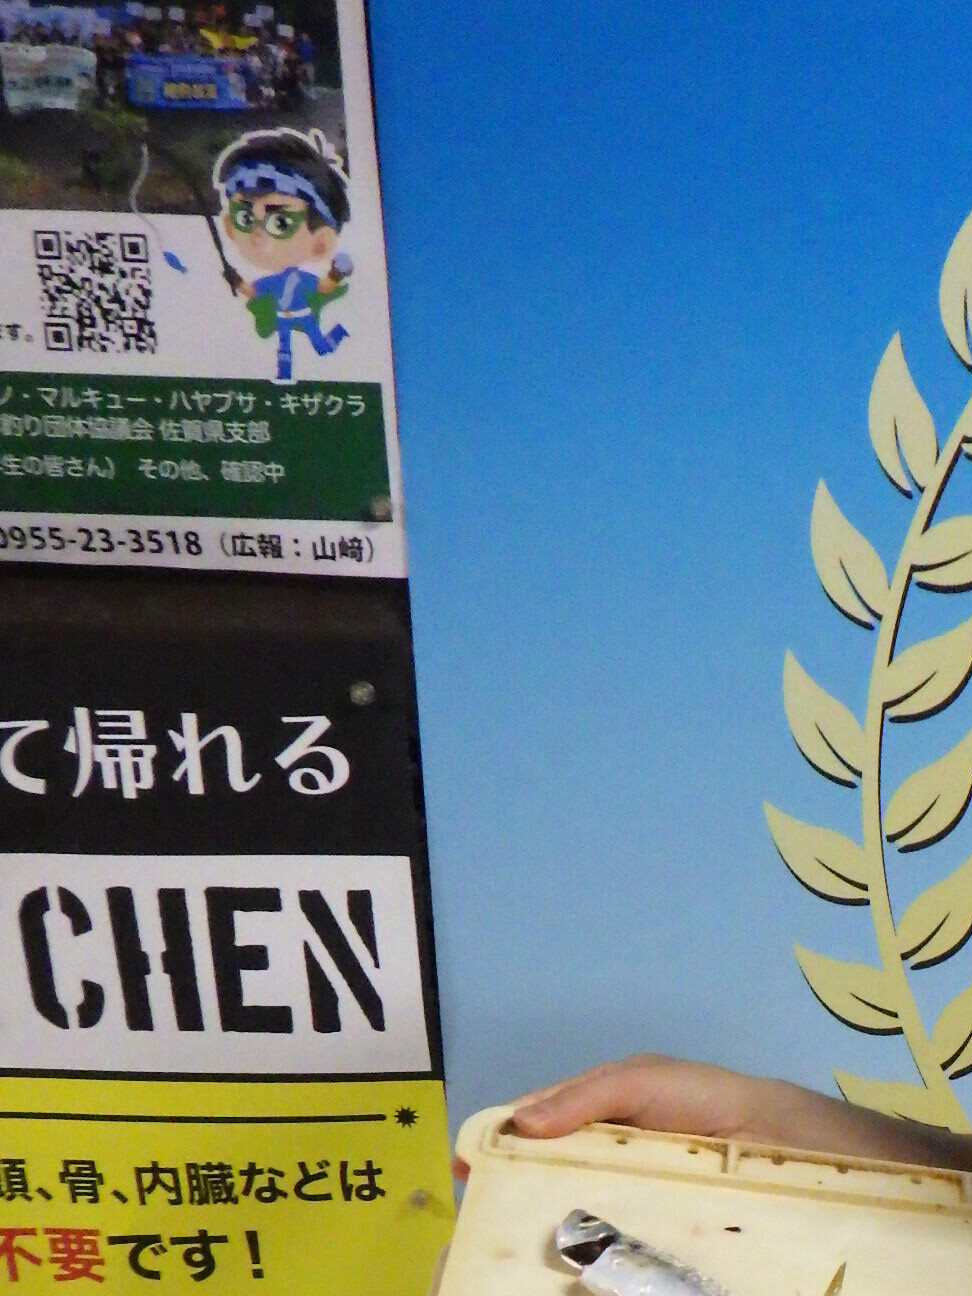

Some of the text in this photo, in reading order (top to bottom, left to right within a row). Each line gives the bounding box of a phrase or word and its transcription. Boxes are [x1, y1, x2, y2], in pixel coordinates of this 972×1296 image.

[0, 322, 34, 343] す。
[0, 706, 350, 800] て帰れる
[18, 884, 387, 1035] CHEN
